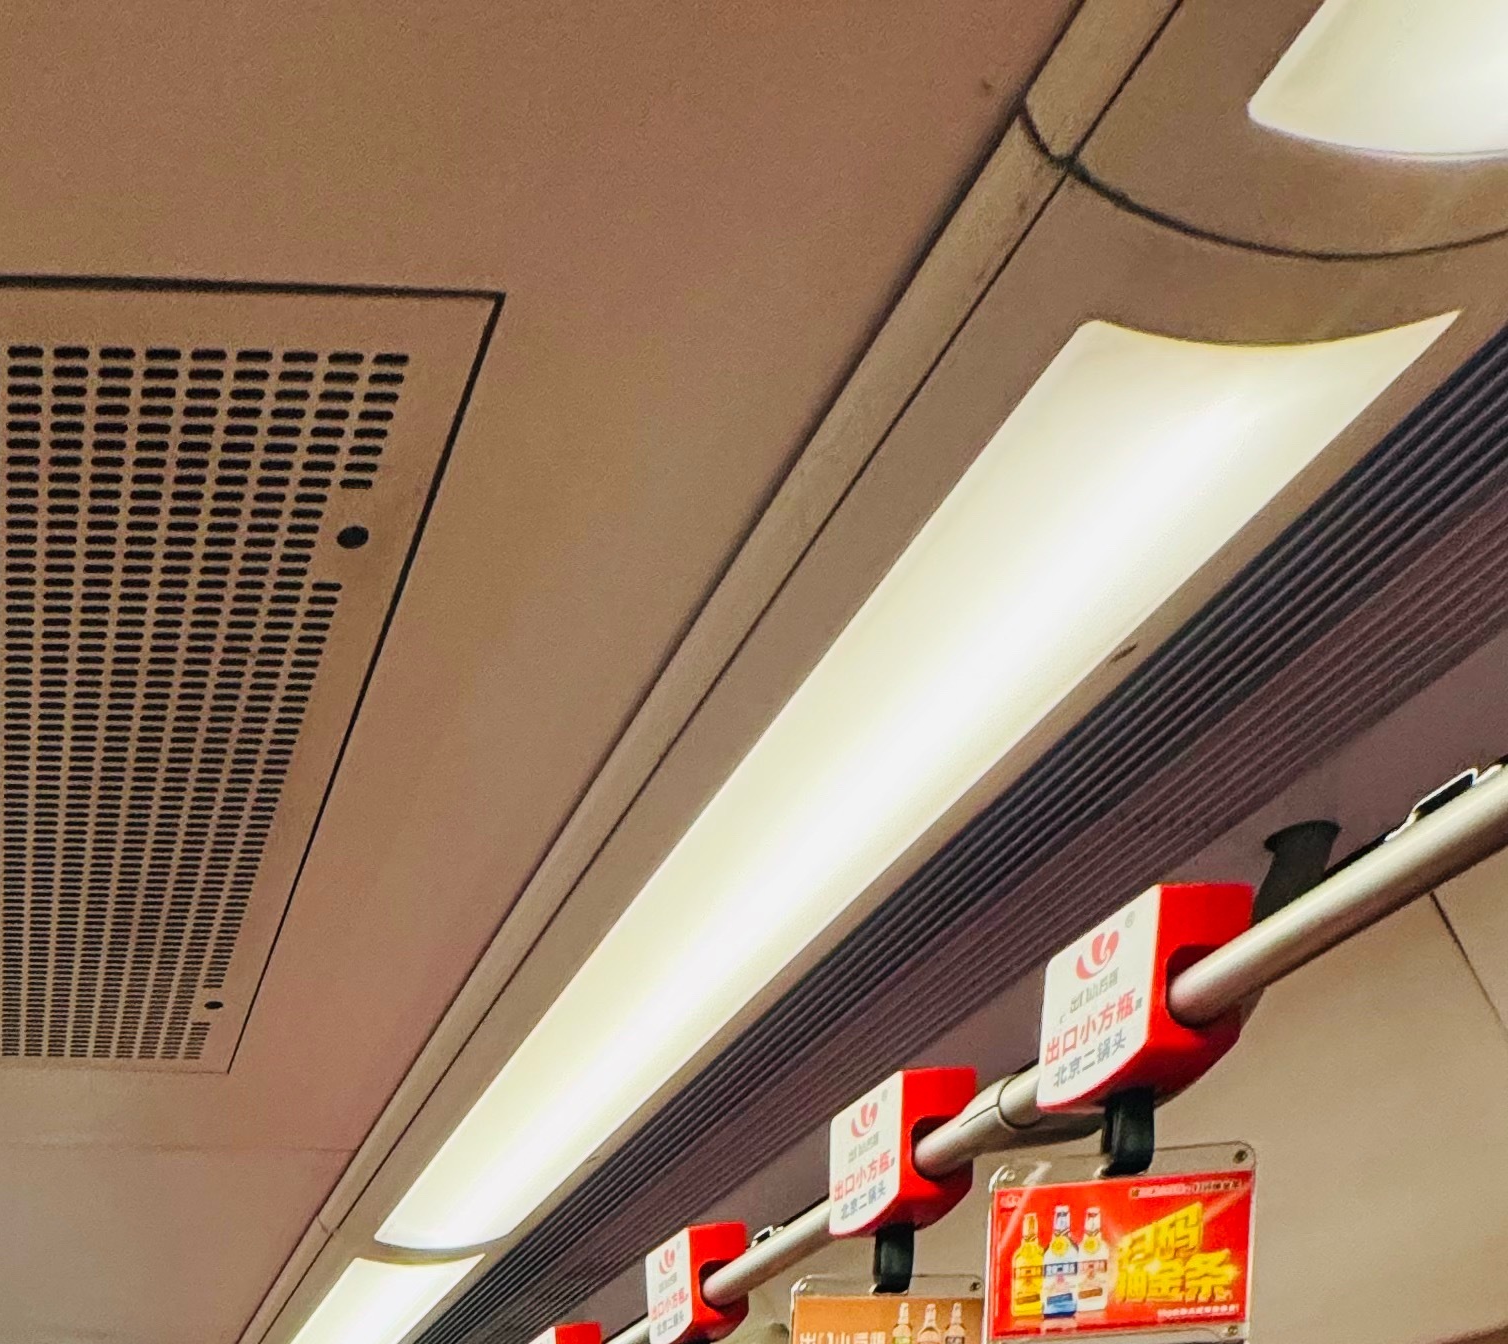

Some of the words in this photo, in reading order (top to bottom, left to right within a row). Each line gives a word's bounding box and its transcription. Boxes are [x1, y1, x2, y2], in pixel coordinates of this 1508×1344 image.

[1053, 1029, 1127, 1088] 北京二锅头
[1118, 1201, 1203, 1262] 扫码
